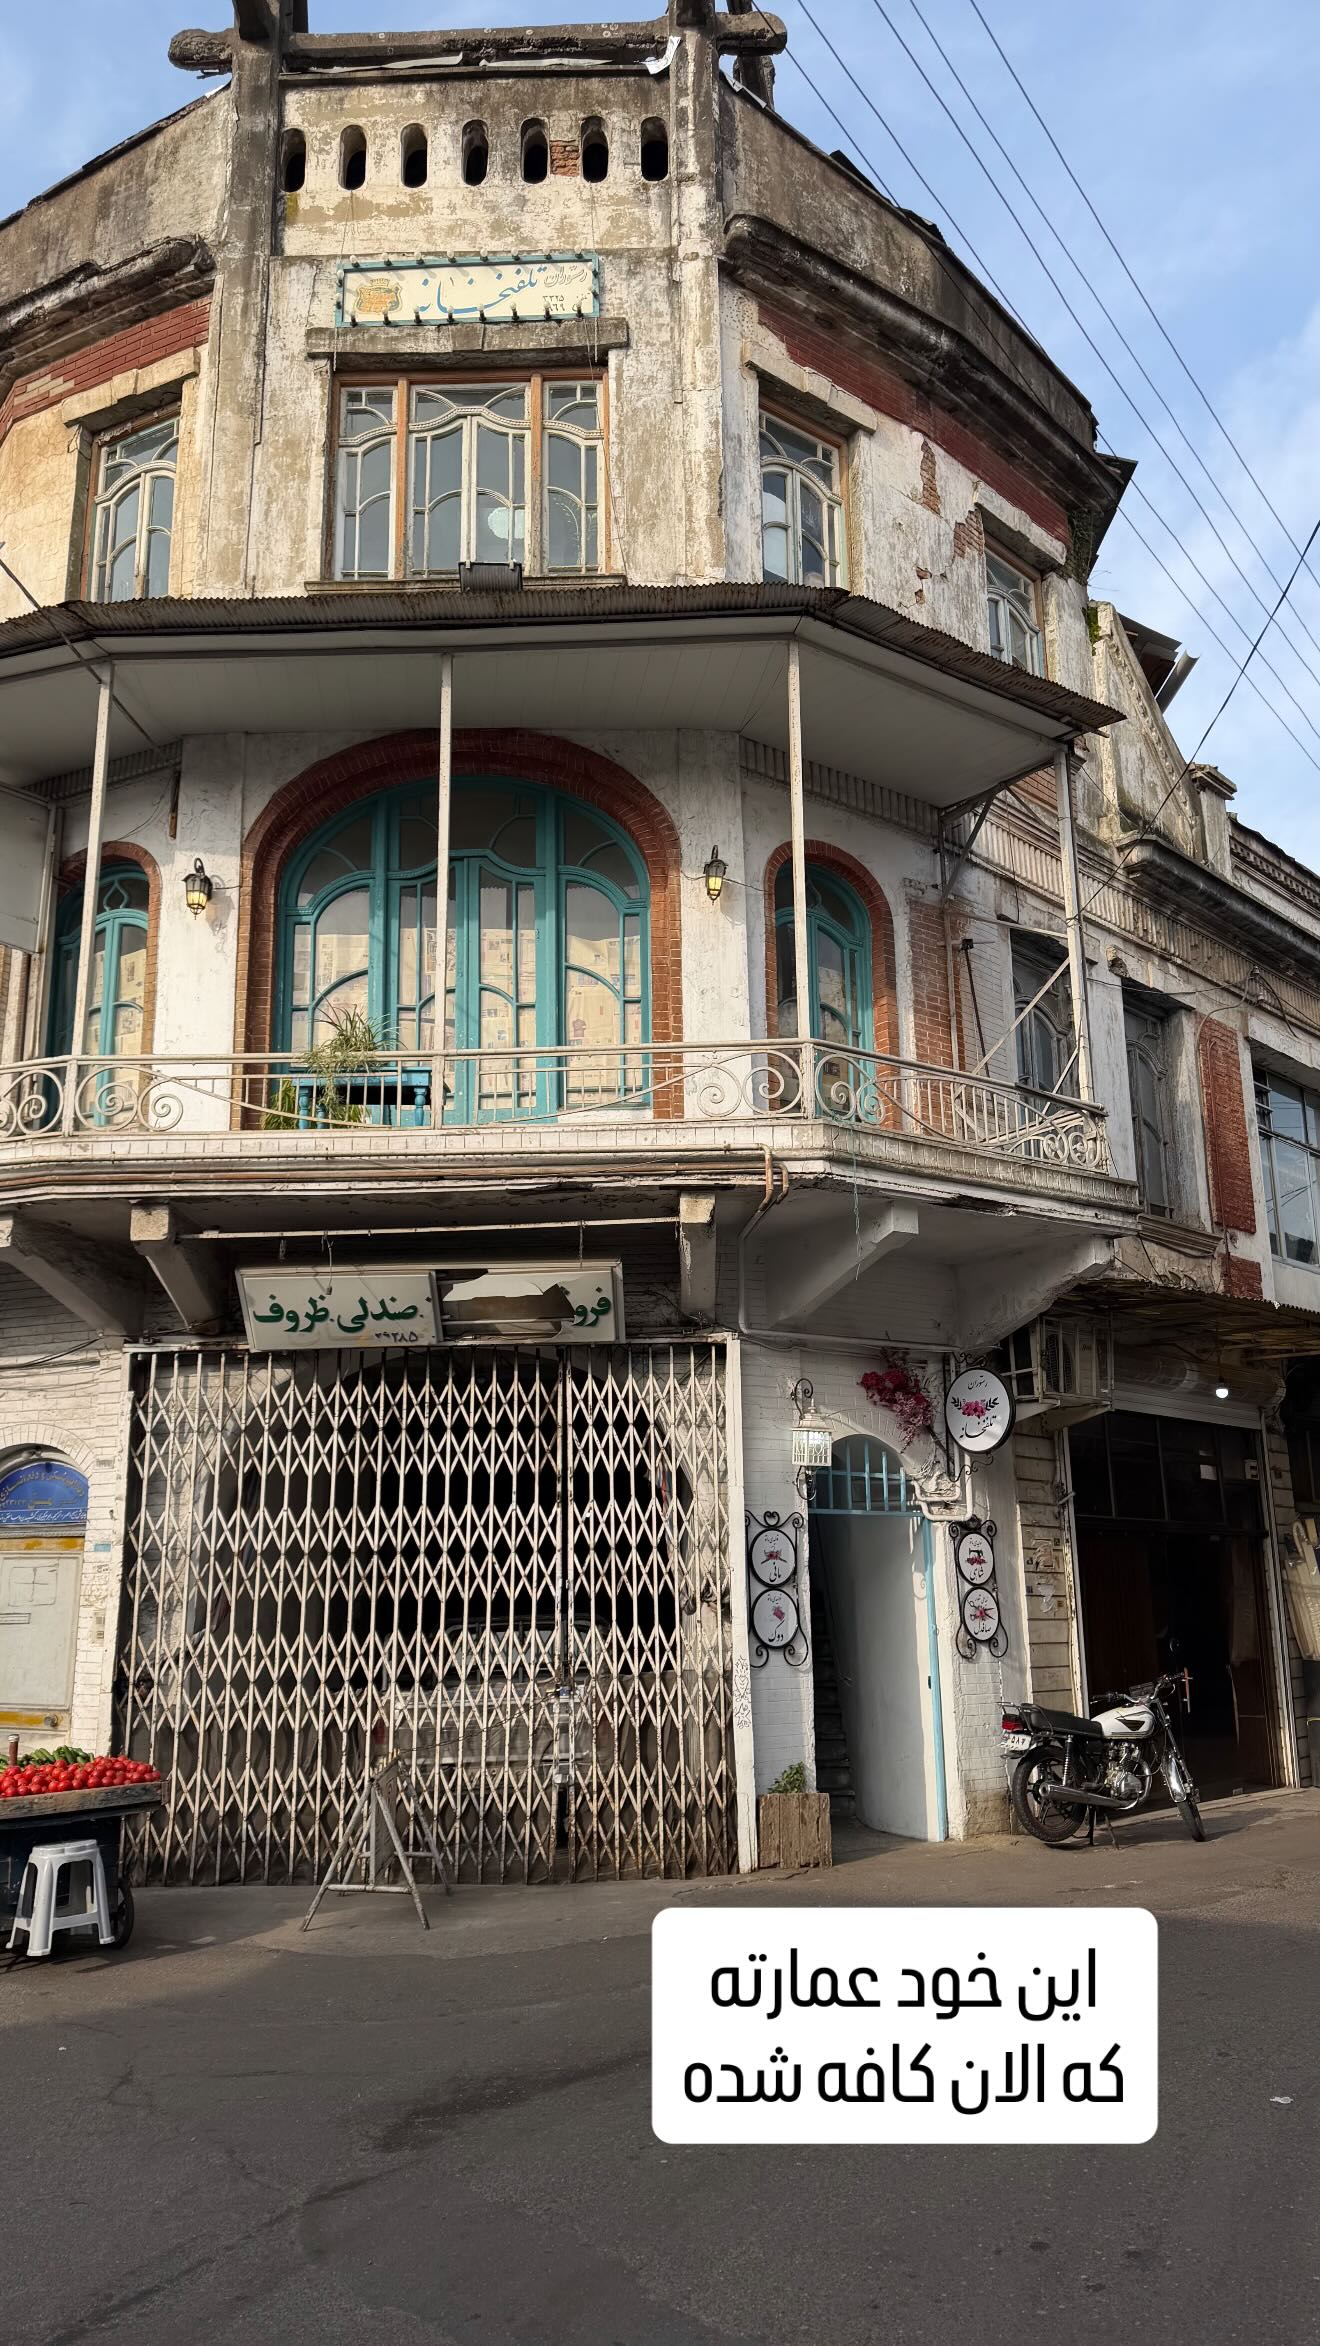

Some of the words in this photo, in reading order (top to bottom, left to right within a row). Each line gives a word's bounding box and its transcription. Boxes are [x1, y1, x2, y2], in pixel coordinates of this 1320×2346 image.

[253, 1293, 330, 1333] ظروف
[337, 1296, 419, 1333] صندلی
[768, 1620, 785, 1642] دوک
